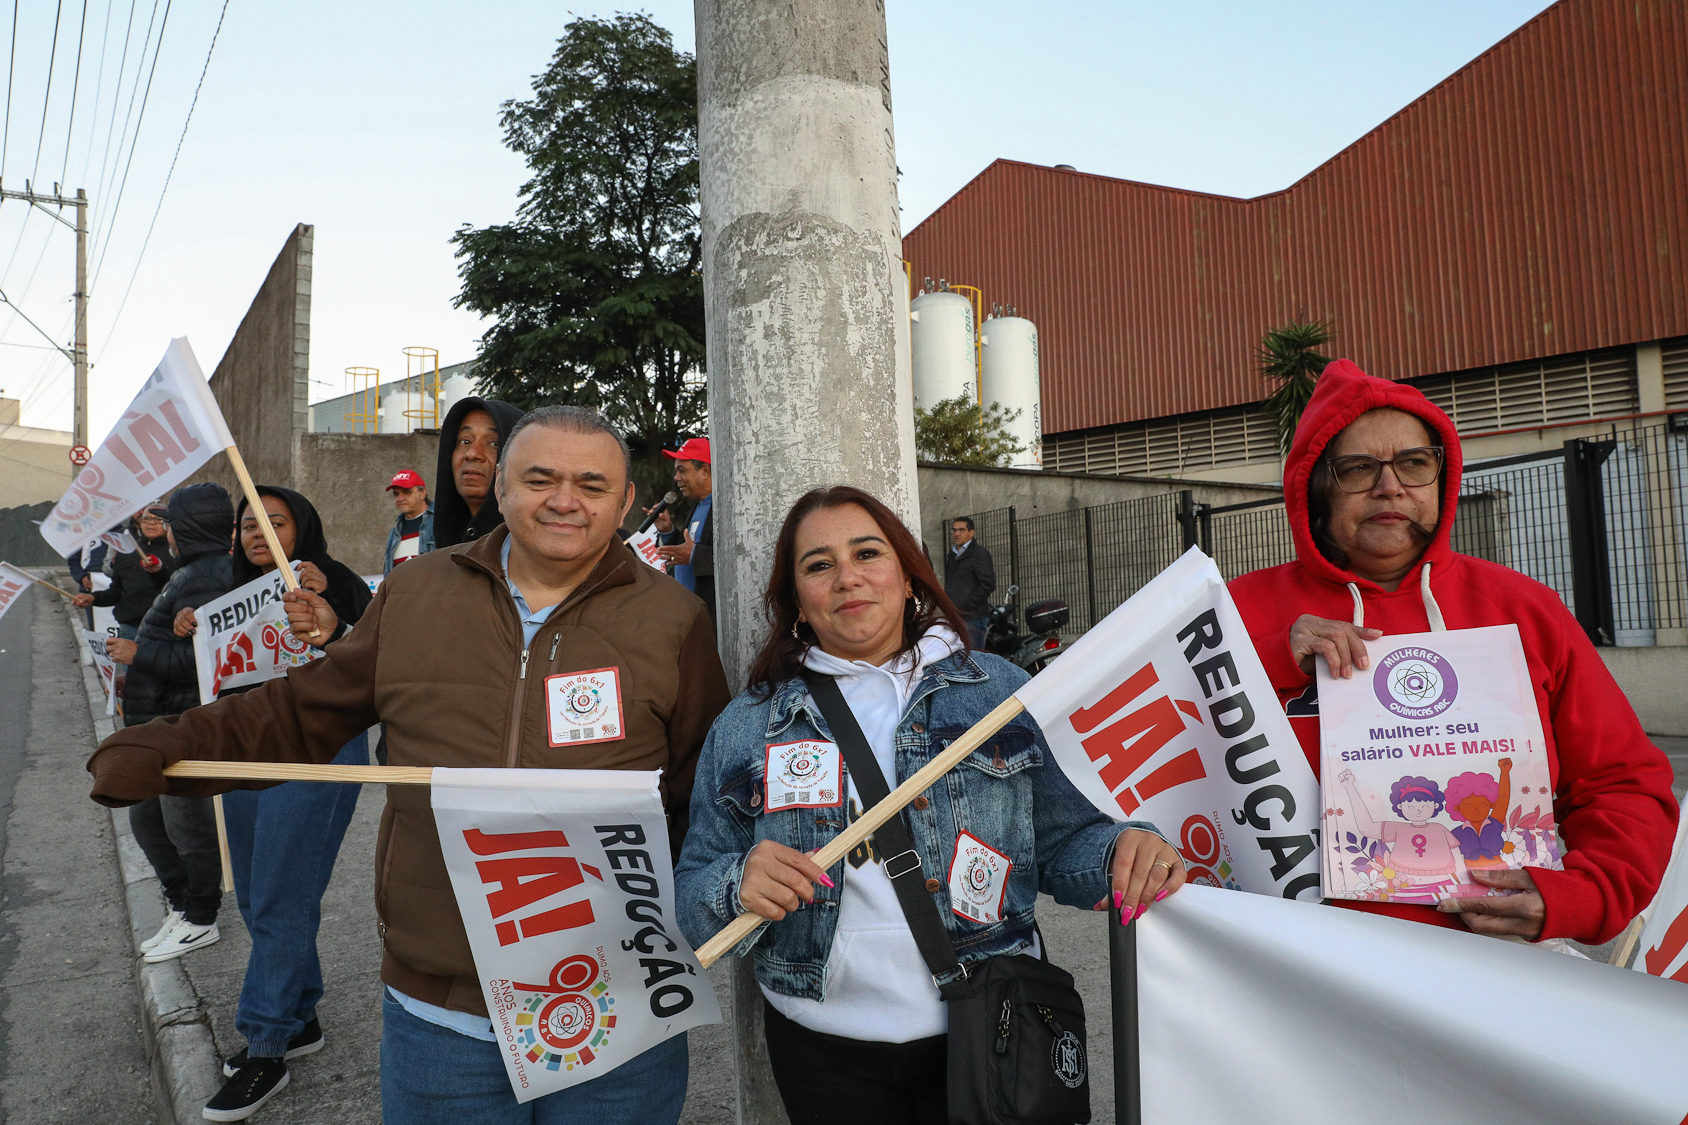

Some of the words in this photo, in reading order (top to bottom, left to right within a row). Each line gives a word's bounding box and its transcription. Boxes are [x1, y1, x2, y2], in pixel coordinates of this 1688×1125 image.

[1383, 648, 1440, 668] MULHERES
[560, 680, 574, 693] Fim
[590, 677, 604, 688] 6x1
[1389, 702, 1434, 717] QUÍMICAS
[1433, 698, 1451, 713] ABC
[1068, 661, 1208, 818] JÁ!
[1368, 725, 1440, 740] Mulher:
[1445, 722, 1480, 735] seu
[780, 747, 796, 759] Fim
[812, 745, 827, 755] 6x1
[1340, 745, 1403, 762] salário
[1408, 742, 1457, 758] VALE
[1461, 738, 1516, 755] MAIS!
[1212, 810, 1225, 840] RUMO
[1222, 844, 1233, 863] AOS
[966, 847, 978, 856] Fim
[980, 848, 988, 856] do
[989, 856, 999, 872] 6x1
[461, 827, 605, 948] JÁ!
[593, 823, 697, 1019] REDUÇÃO
[595, 945, 608, 968] RUMO
[602, 969, 612, 983] AOS
[489, 979, 514, 1043] CONSTRUINDO
[498, 979, 517, 1011] ANOS
[575, 997, 593, 1031] QUÍMICOS
[509, 1043, 517, 1052] O
[512, 1052, 530, 1089] FUTURO
